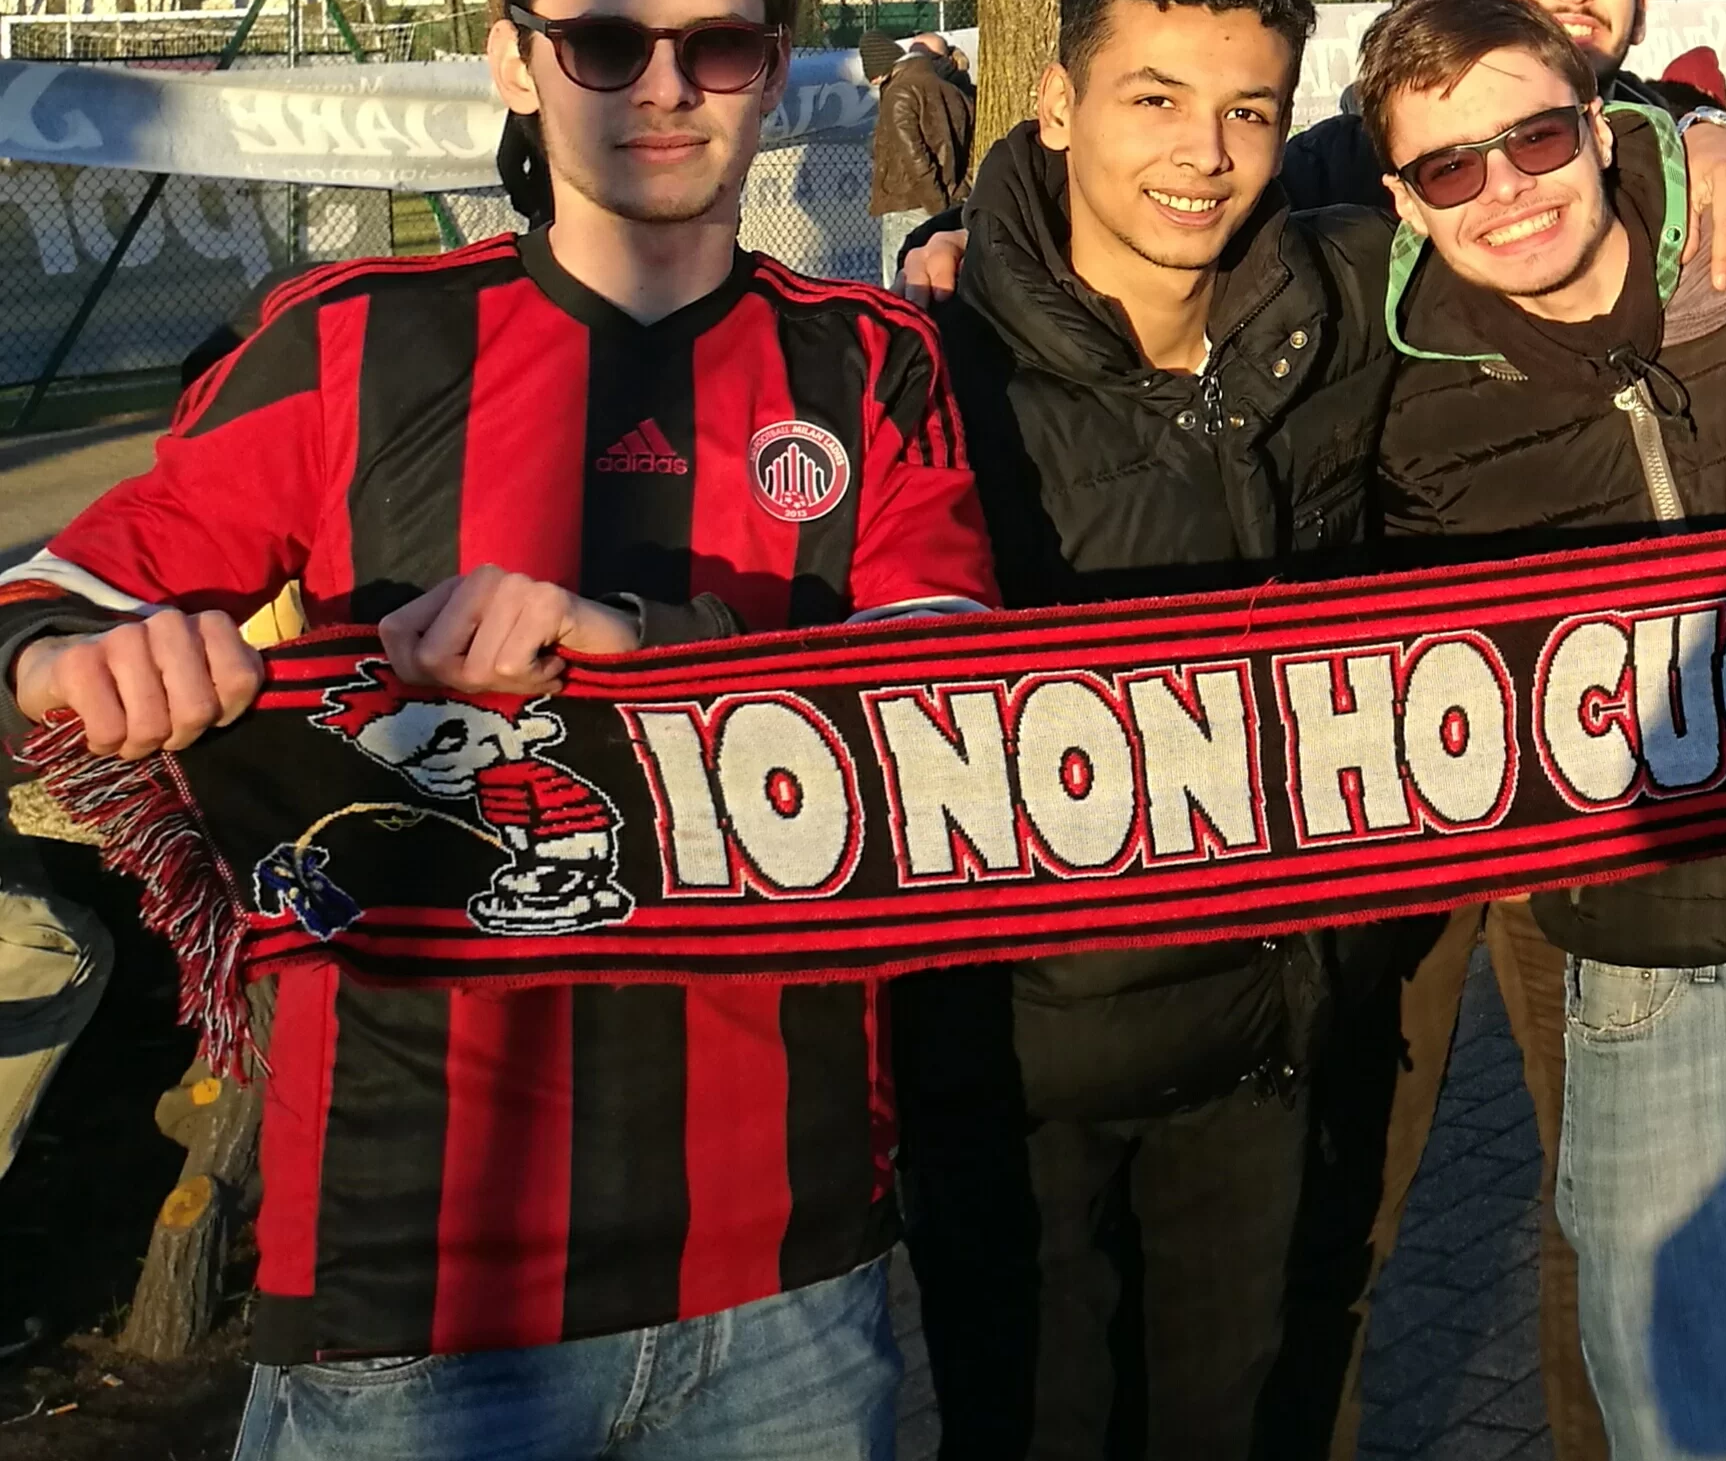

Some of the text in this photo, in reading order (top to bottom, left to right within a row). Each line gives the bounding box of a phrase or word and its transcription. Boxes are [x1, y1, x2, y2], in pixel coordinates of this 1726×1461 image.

[595, 454, 688, 475] adidas
[792, 425, 825, 442] MILAN
[823, 437, 845, 466] LADIES
[616, 690, 866, 899] IO
[858, 657, 1271, 889] NON
[1272, 629, 1519, 849] HO
